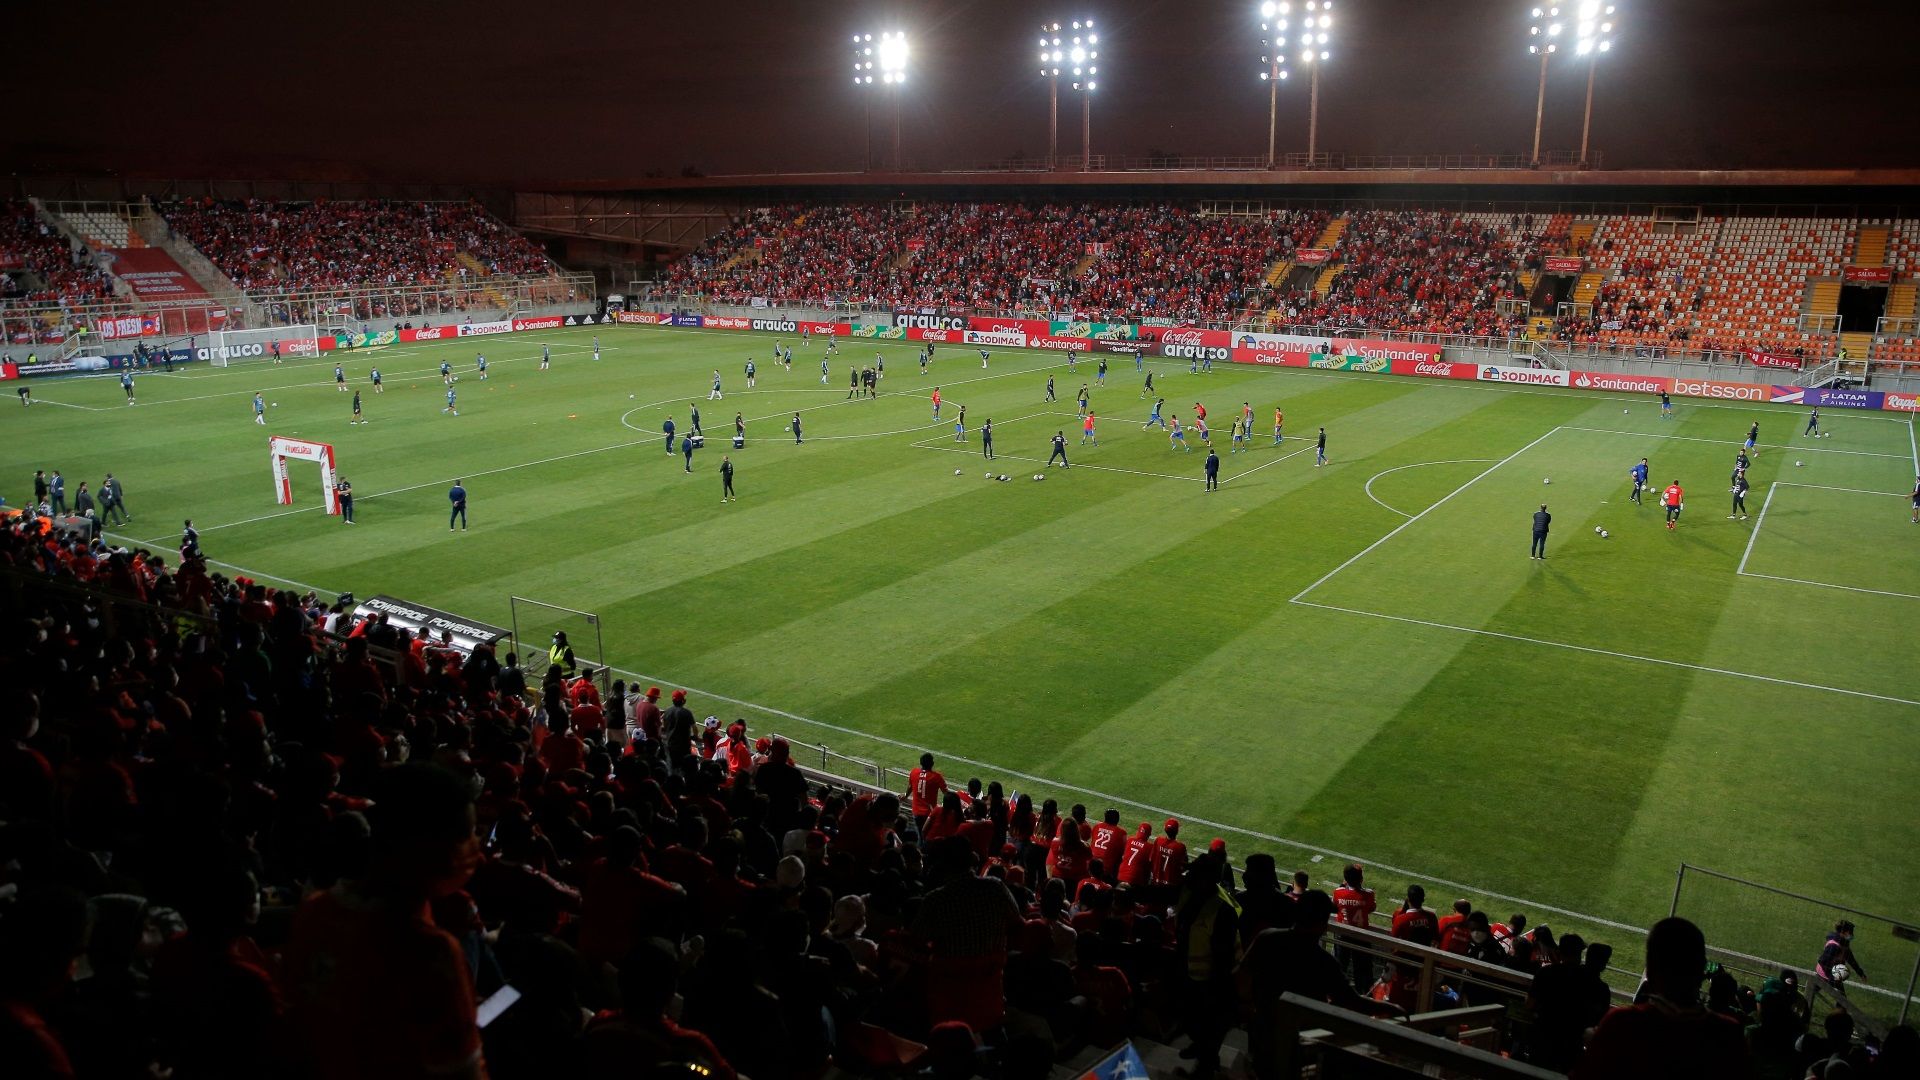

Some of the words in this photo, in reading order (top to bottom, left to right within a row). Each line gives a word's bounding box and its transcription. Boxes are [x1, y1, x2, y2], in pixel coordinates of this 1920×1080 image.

[619, 312, 656, 324] betsson
[473, 325, 508, 335] SODIMAC
[525, 320, 560, 330] Santander
[753, 319, 795, 332] arauco
[815, 325, 832, 334] Claro
[993, 324, 1019, 333] Claro
[980, 335, 1020, 345] SODIMAC
[1041, 338, 1086, 351] Santander
[197, 343, 262, 361] arauco
[289, 343, 312, 352] Claro
[1164, 344, 1228, 360] arauco
[1360, 346, 1429, 362] Santander
[1256, 353, 1280, 364] Claro
[1315, 356, 1344, 369] CRISTAL
[1354, 359, 1384, 372] CRISTAL
[1501, 371, 1561, 385] SODIMAC
[1593, 377, 1660, 392] Santander
[1674, 378, 1762, 401] betsson
[1831, 393, 1867, 401] LATAM
[1888, 395, 1916, 410] Rapp
[1830, 400, 1866, 408] AIRLINES
[366, 598, 430, 622] POWERADE
[427, 617, 497, 641] POWERADE
[1094, 831, 1111, 850] 22
[1128, 847, 1139, 866] 7
[1162, 855, 1169, 871] 7
